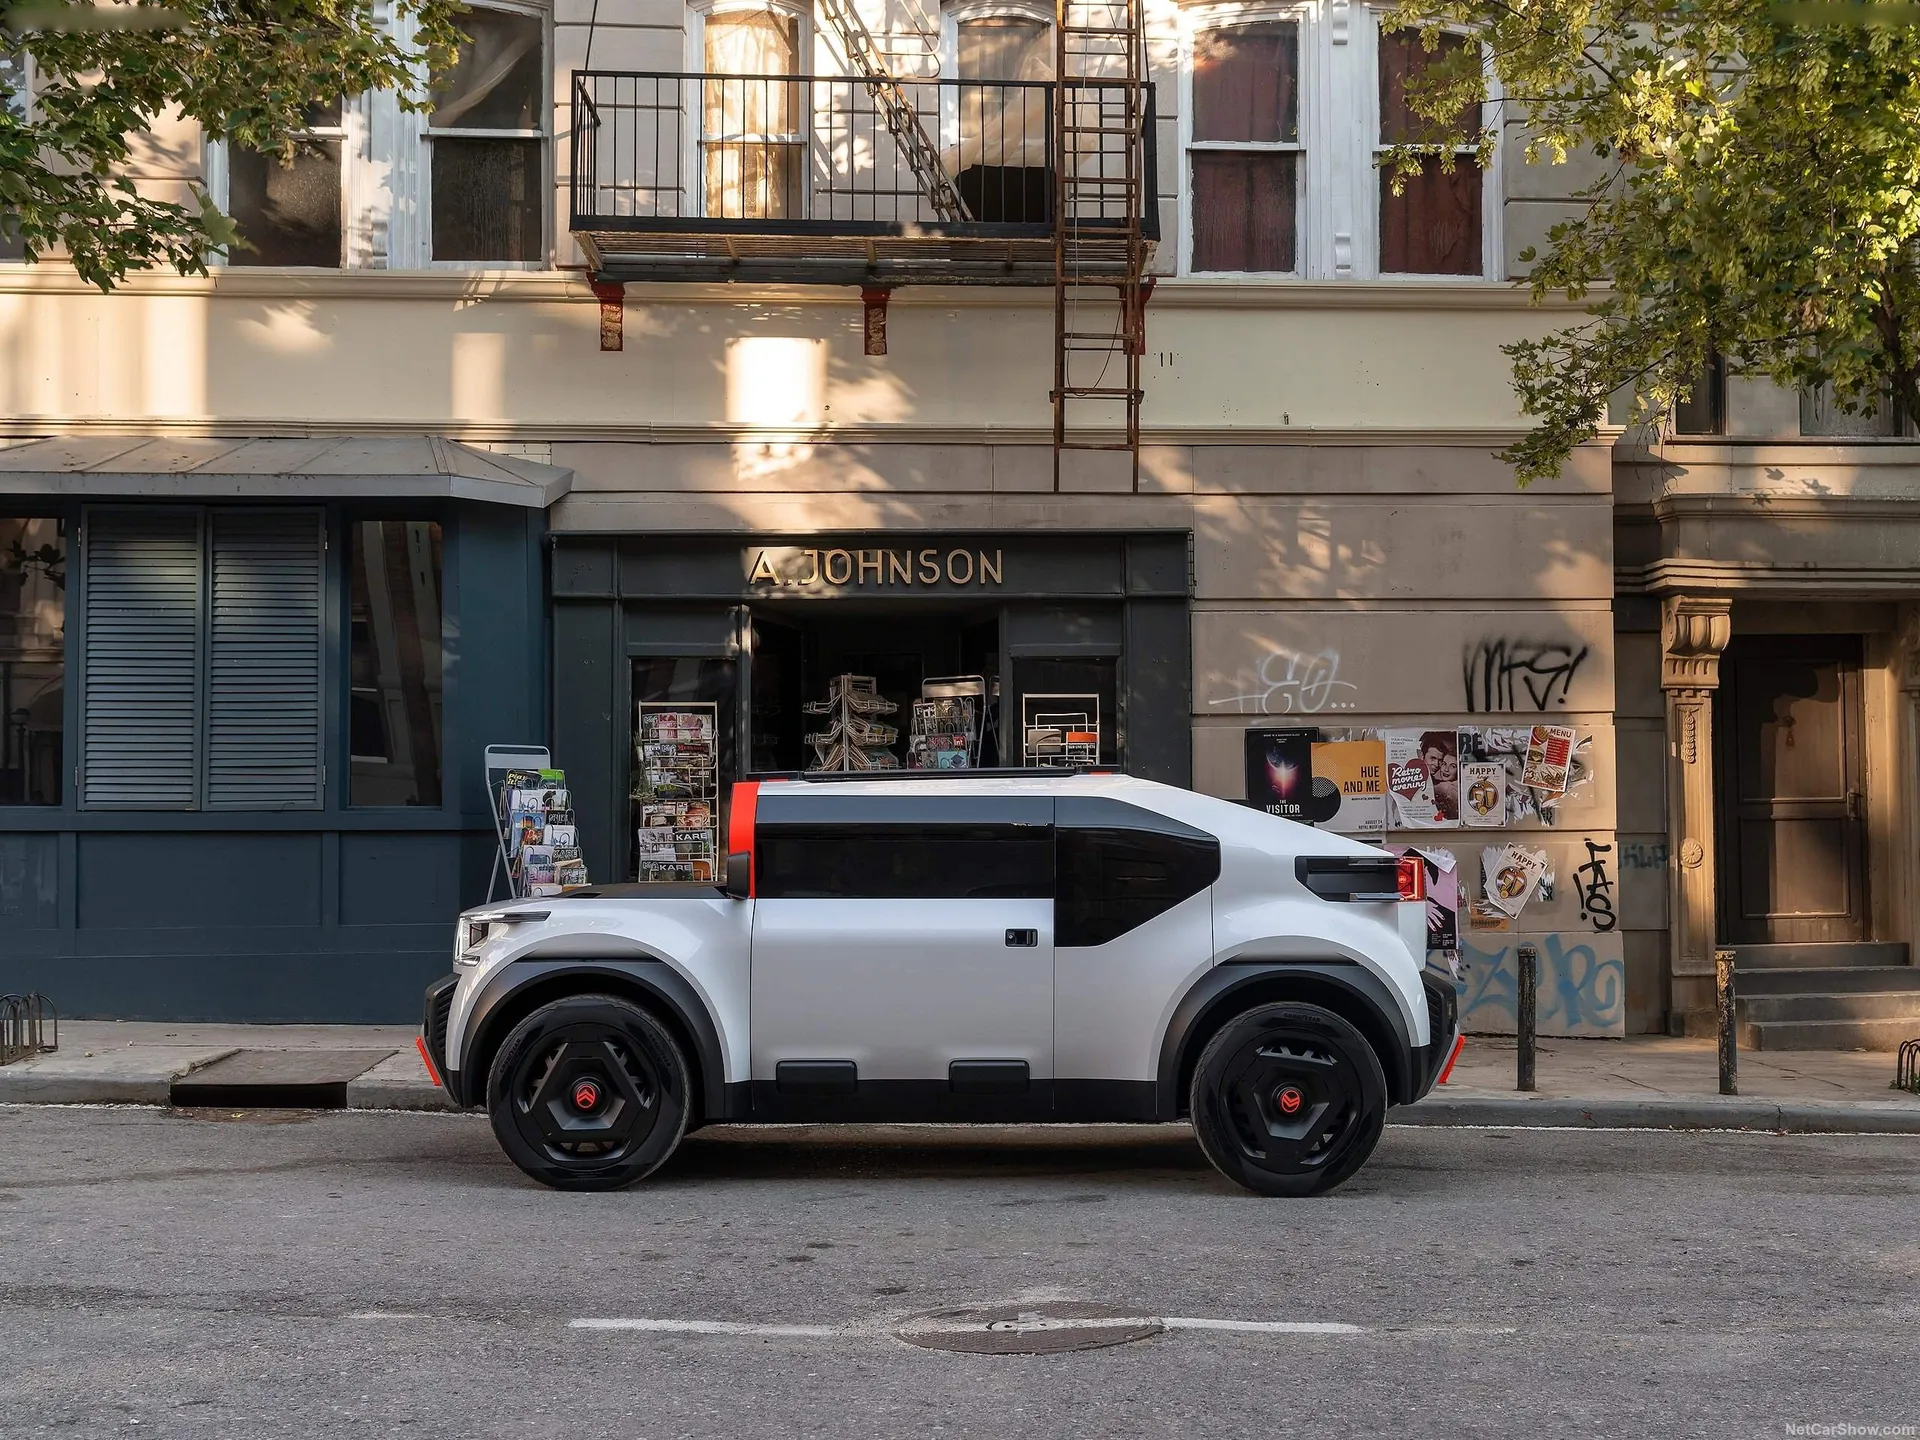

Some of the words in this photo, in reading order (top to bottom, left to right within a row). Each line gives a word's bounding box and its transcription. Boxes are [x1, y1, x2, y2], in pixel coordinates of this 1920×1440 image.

[1549, 728, 1572, 738] MENU
[1361, 766, 1379, 778] HUE
[1391, 766, 1422, 778] Retro
[1469, 767, 1496, 775] HAPPY
[1392, 774, 1424, 785] movies
[1343, 781, 1363, 793] AND
[1366, 780, 1381, 792] ME
[1392, 781, 1426, 791] evening
[1266, 804, 1301, 814] VISITOR
[676, 832, 708, 841] KARE
[1511, 850, 1537, 870] HAPPY
